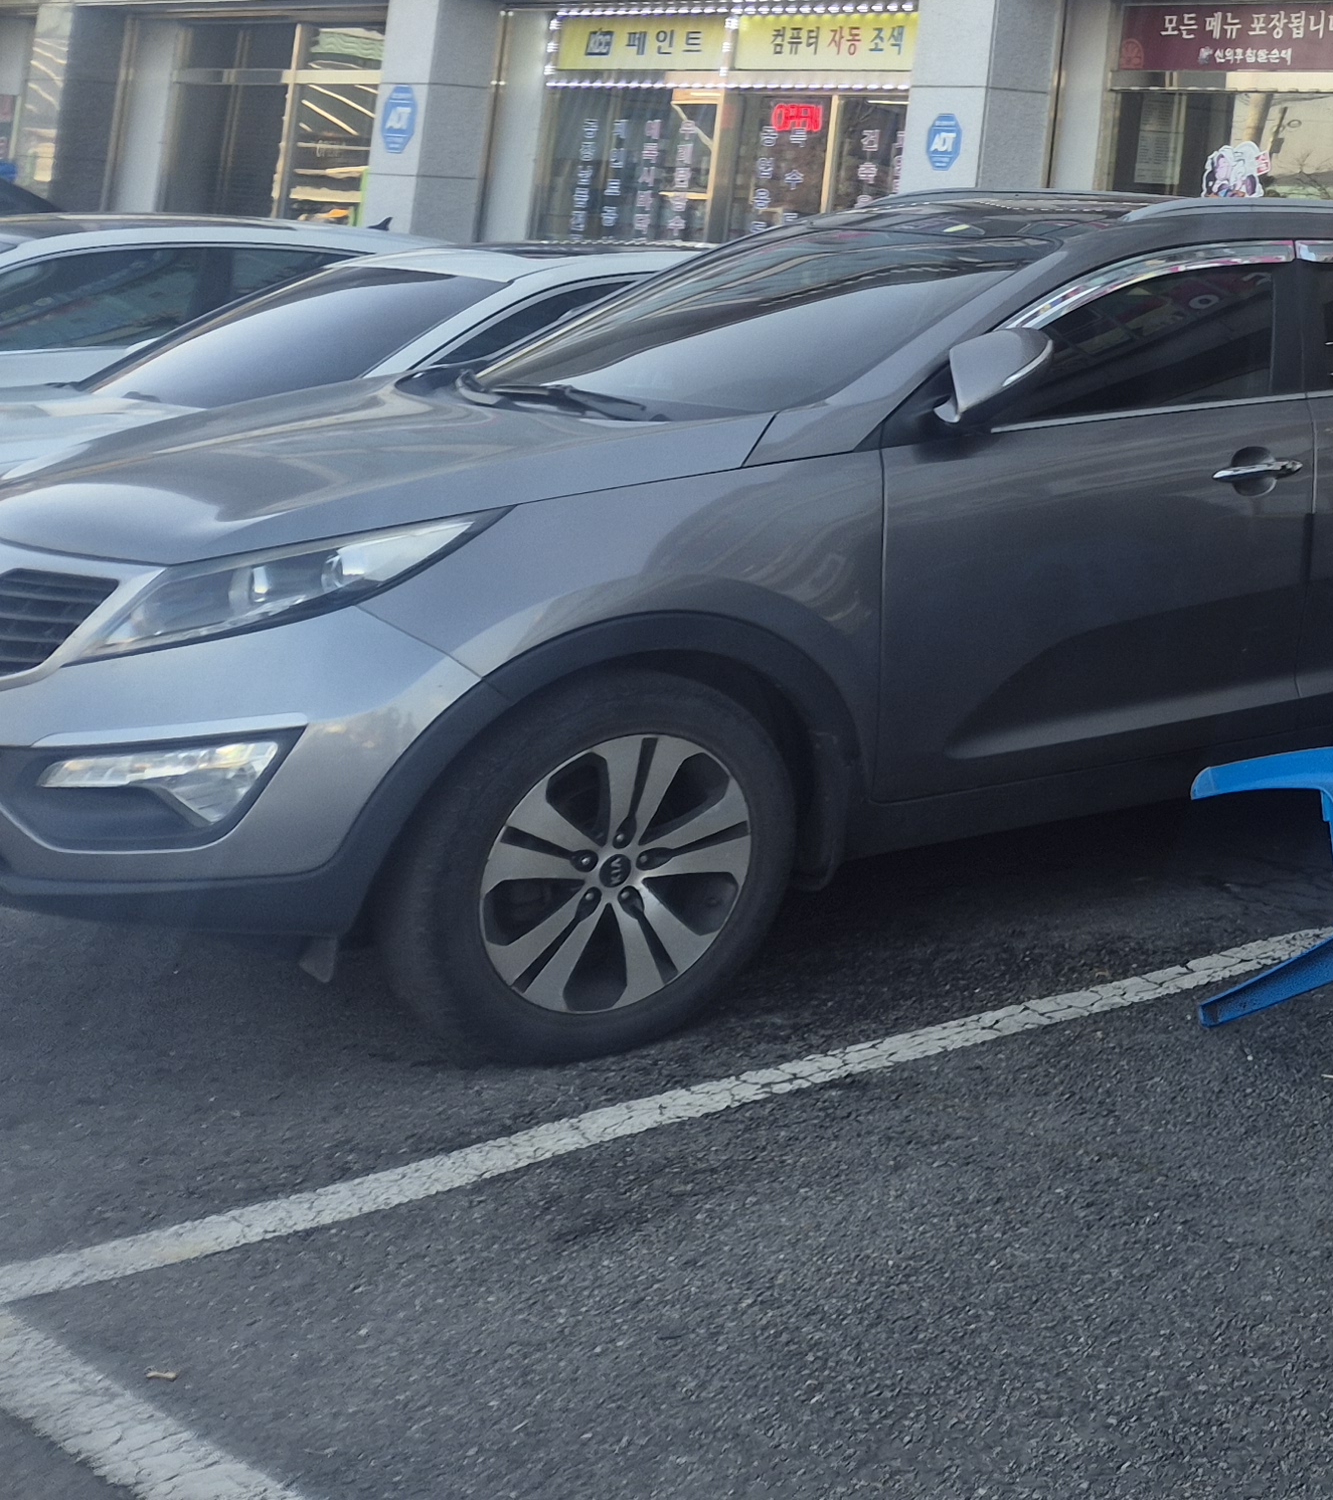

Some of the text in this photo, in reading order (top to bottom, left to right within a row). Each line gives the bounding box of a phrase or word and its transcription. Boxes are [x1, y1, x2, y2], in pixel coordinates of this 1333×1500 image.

[1159, 13, 1199, 40] 모든
[1205, 10, 1243, 40] 메뉴
[625, 30, 704, 56] 페인트
[770, 24, 905, 57] 컴퓨터 자동 조색
[385, 106, 412, 130] ADT
[770, 102, 823, 133] OPEN
[929, 131, 957, 153] ADT
